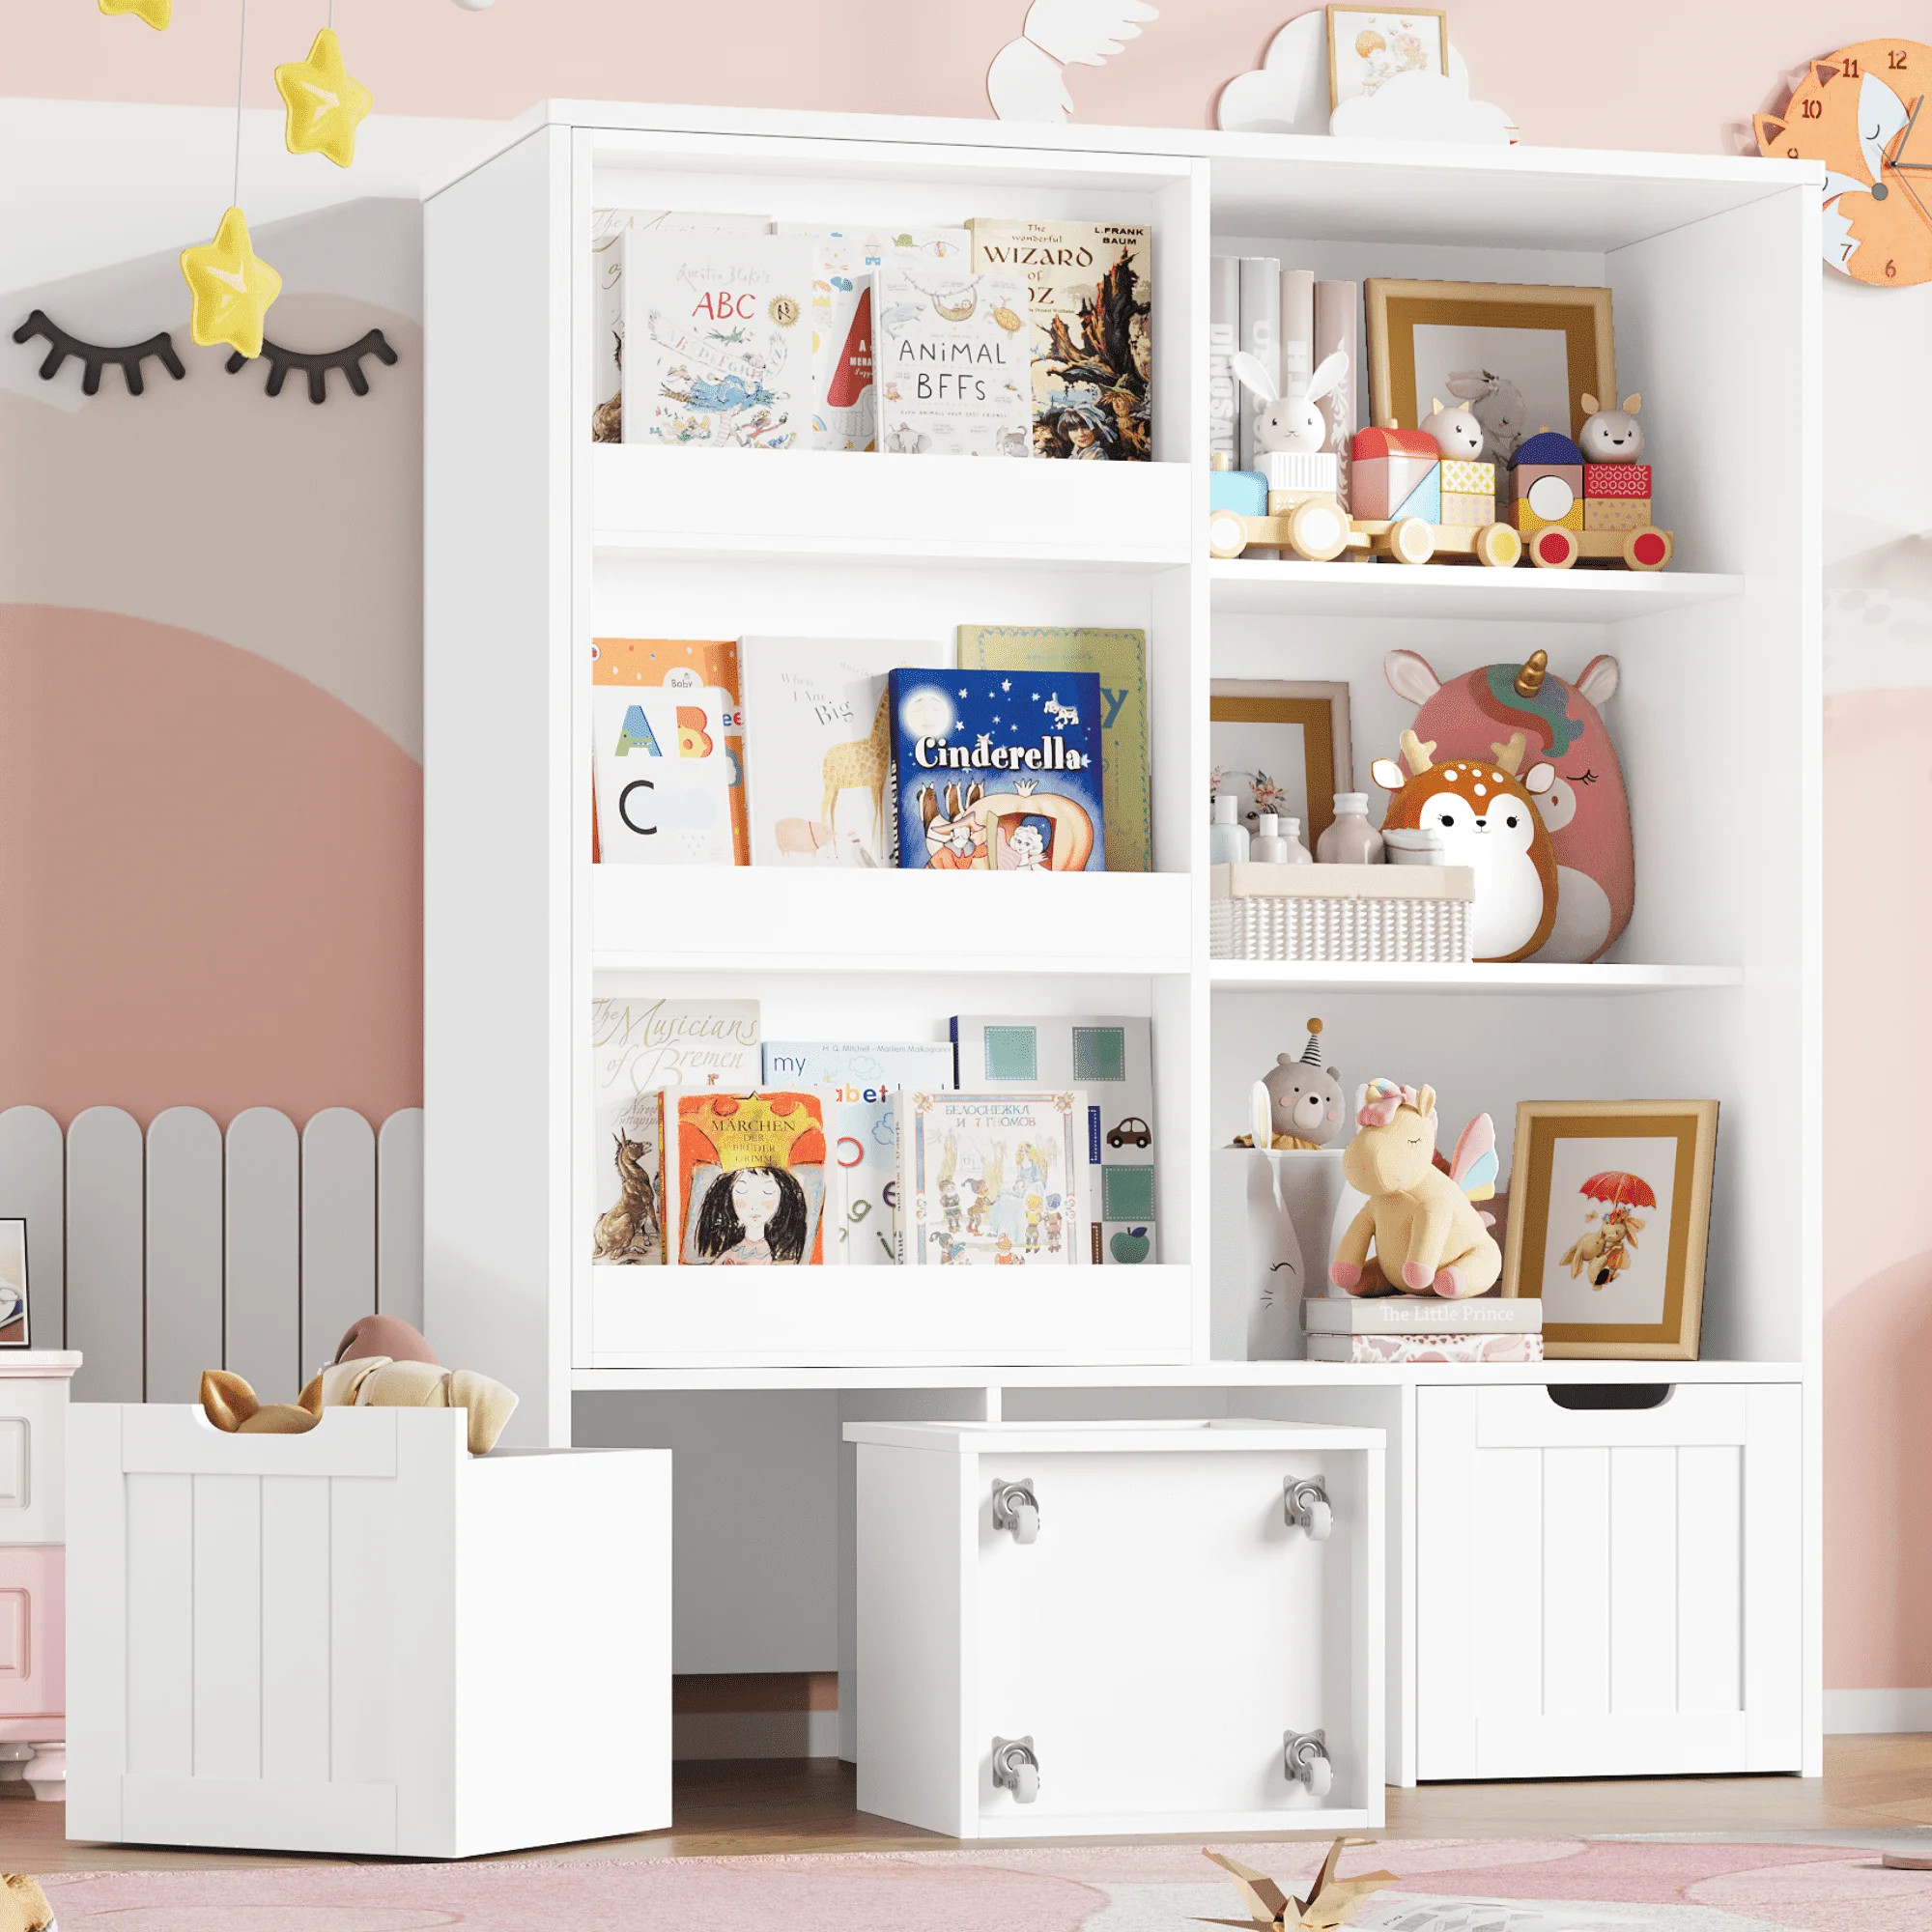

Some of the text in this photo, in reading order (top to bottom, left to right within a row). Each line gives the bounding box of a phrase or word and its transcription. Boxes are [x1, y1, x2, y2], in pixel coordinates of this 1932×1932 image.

[1842, 58, 1860, 78] 11
[1888, 50, 1907, 70] 12
[1802, 99, 1822, 119] 10
[1012, 234, 1063, 243] wonderful
[1027, 224, 1045, 233] The
[1840, 242, 1852, 262] 7
[1885, 259, 1896, 278] 6
[692, 291, 756, 321] ABC
[670, 678, 693, 689] Baby
[814, 700, 854, 725] Big
[614, 704, 664, 757] A
[915, 735, 1082, 771] Cinderella
[618, 779, 658, 836] C
[593, 998, 758, 1048] Musicians
[630, 1038, 745, 1095] Bremen
[774, 1056, 806, 1077] my
[945, 1104, 1031, 1116] БЕЛОСНЕЖКА
[711, 1117, 796, 1132] MÄRCHEN
[742, 1133, 764, 1143] DER
[1379, 1306, 1515, 1321] The Little Prince
